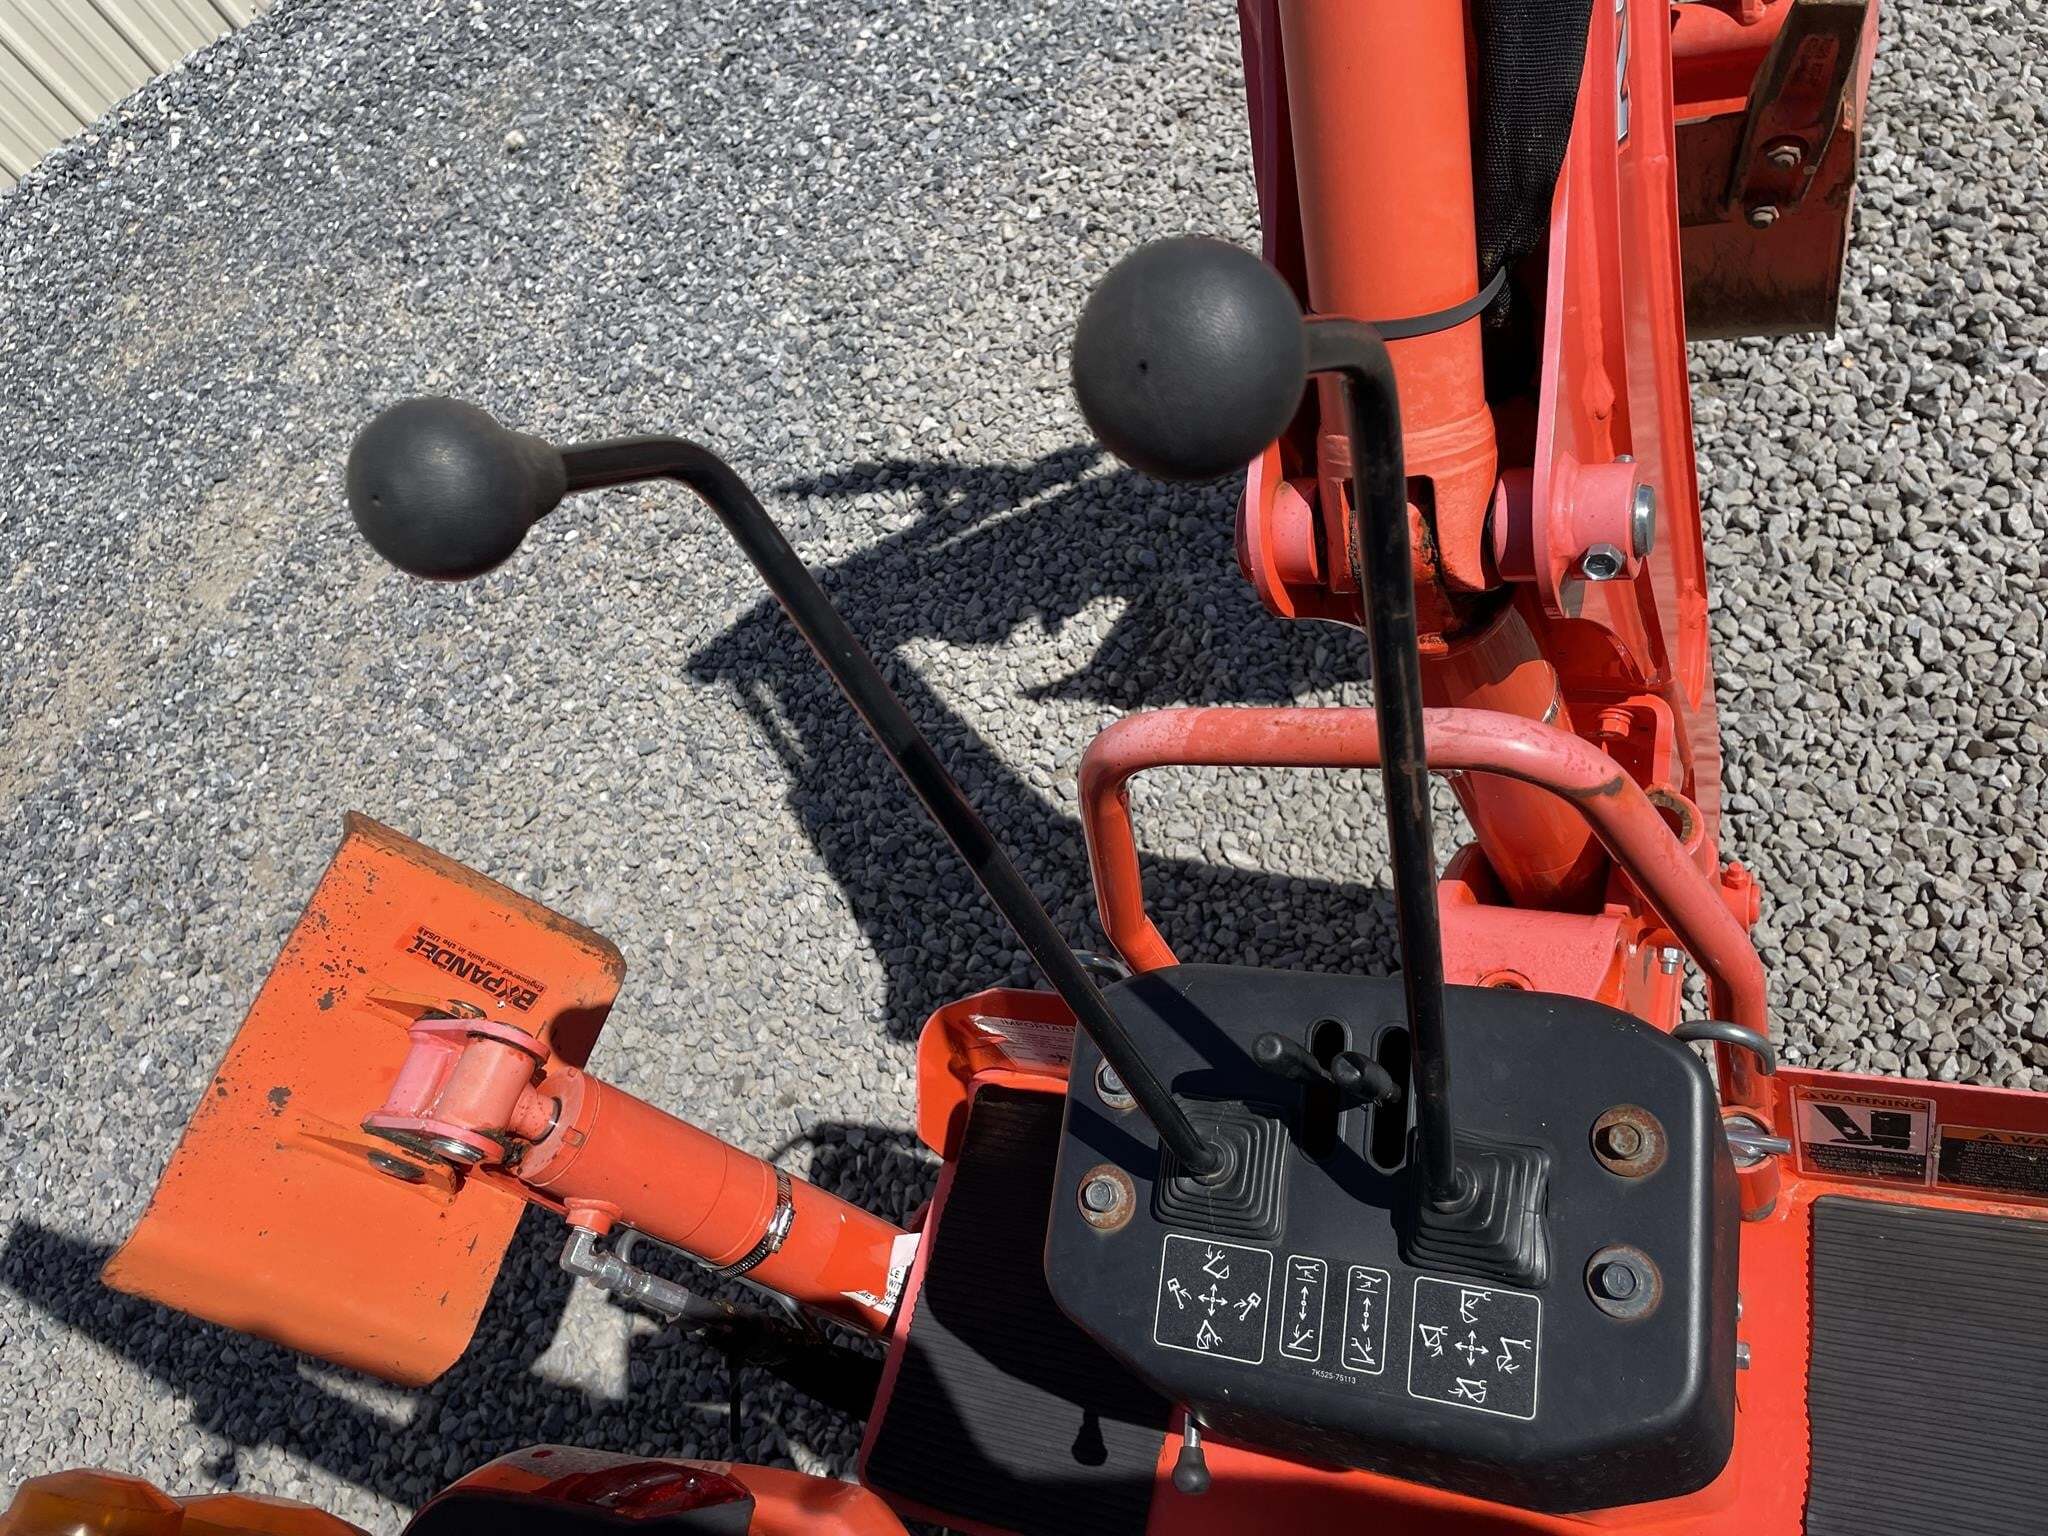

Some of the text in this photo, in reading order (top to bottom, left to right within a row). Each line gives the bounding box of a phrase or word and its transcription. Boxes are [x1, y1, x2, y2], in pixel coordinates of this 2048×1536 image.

[443, 938, 457, 949] the
[467, 950, 486, 964] built
[485, 960, 501, 971] and
[502, 968, 545, 992] Engineered
[1820, 1090, 1927, 1110] WARNING
[1311, 1368, 1356, 1384] 7K525-75113
